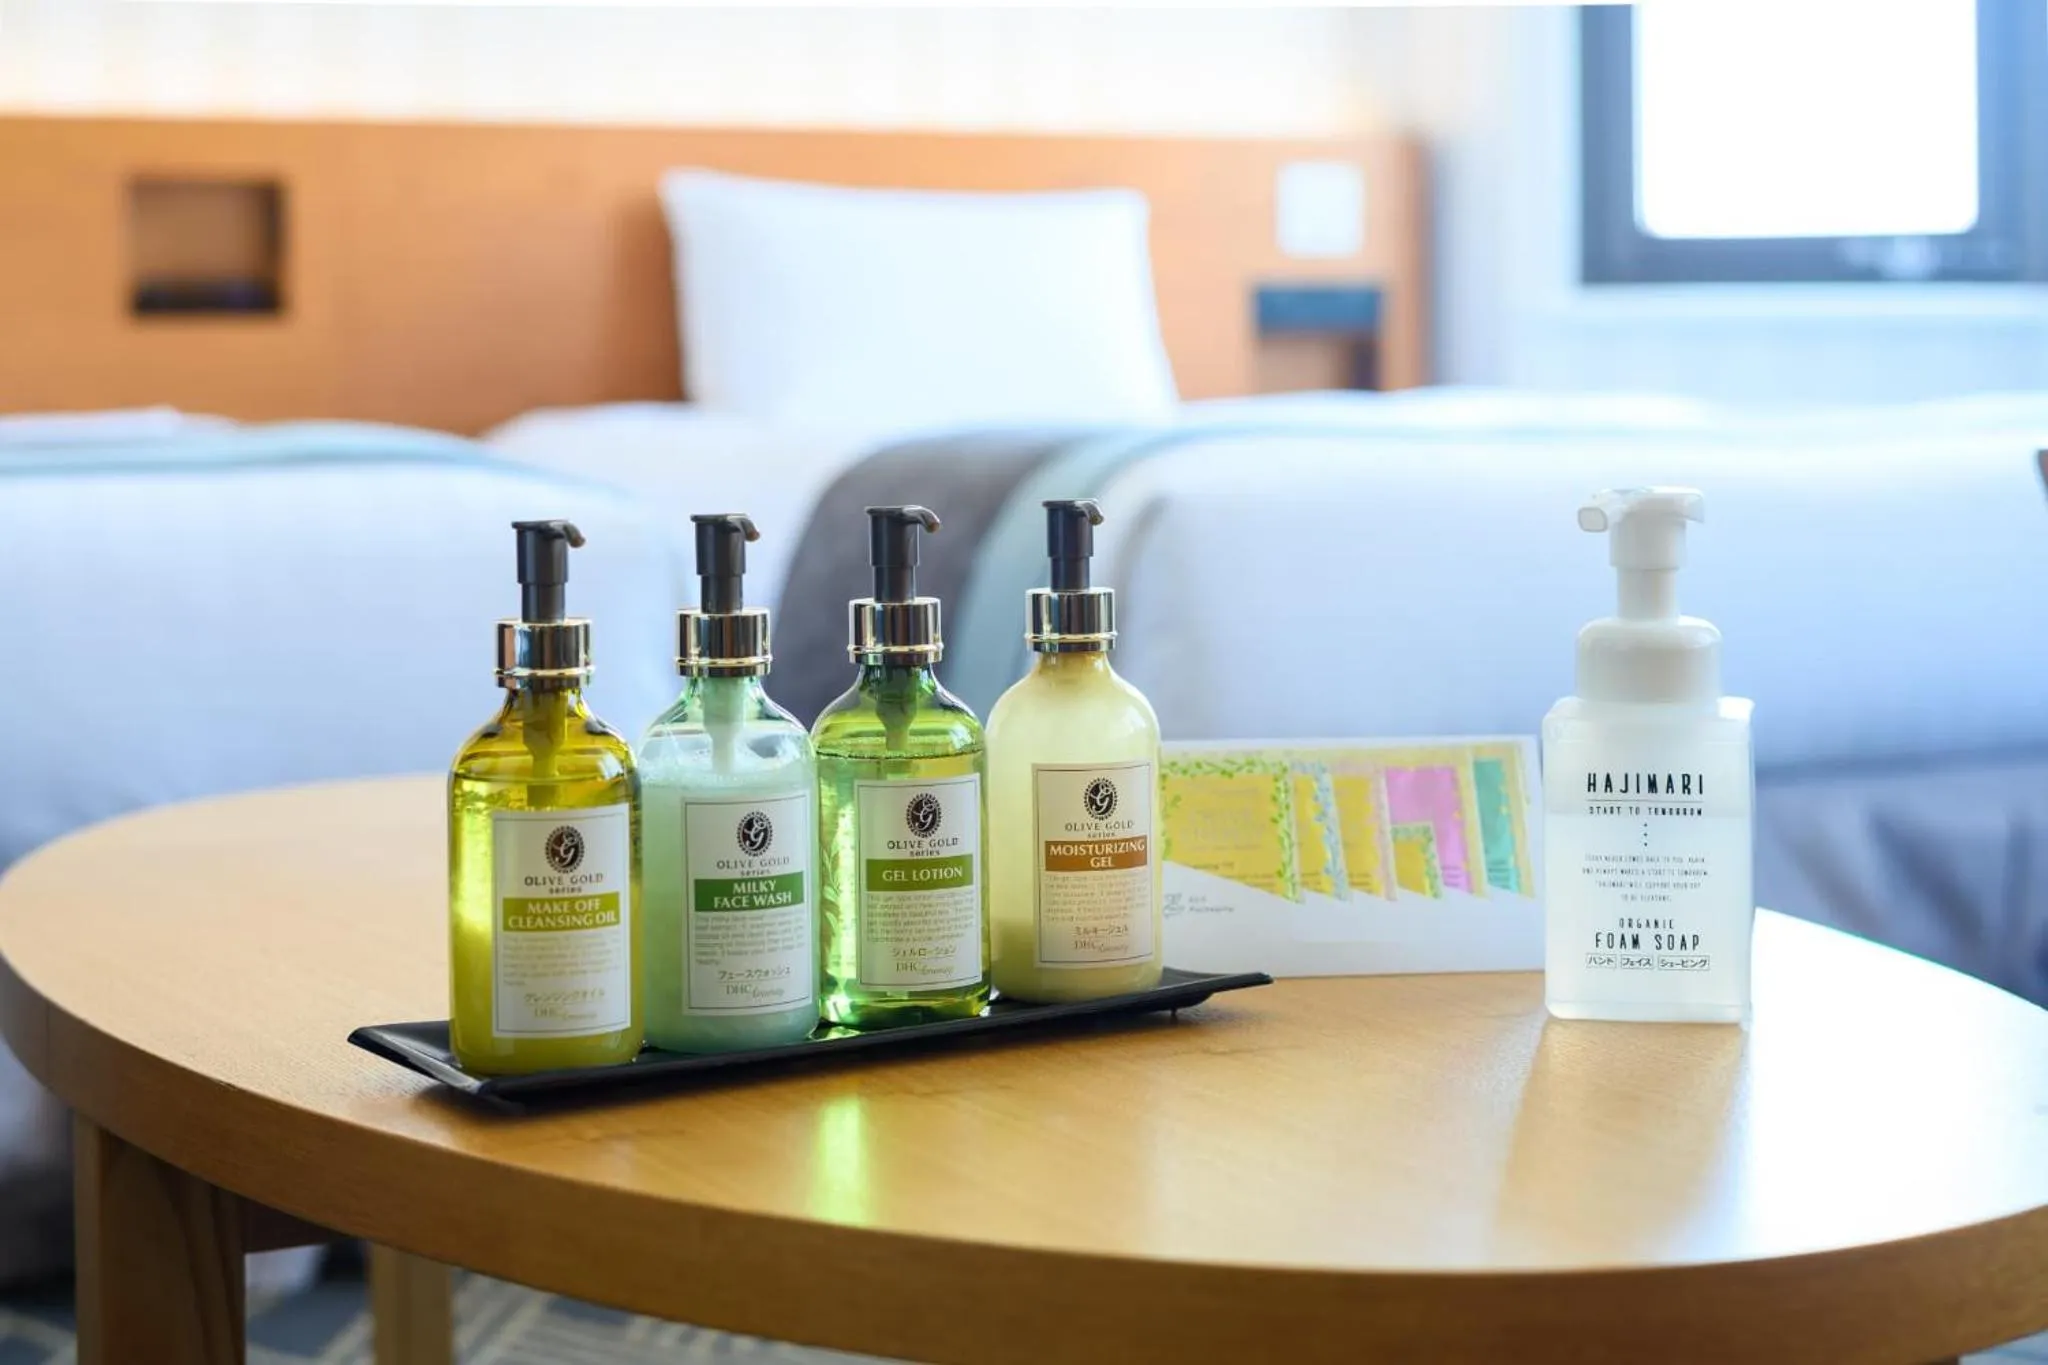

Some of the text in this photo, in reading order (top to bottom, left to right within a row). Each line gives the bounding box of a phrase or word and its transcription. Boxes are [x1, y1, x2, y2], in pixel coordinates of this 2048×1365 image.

[1587, 772, 1704, 795] HAJIMARI
[1589, 806, 1621, 816] START
[1629, 806, 1641, 816] TO
[1064, 820, 1135, 832] OLIVE GOLD
[886, 837, 959, 850] OLIVE GOLD
[1049, 840, 1146, 857] MOISTURIZING
[716, 856, 790, 870] OLIVE GOLD
[1090, 856, 1116, 869] GEL
[524, 873, 604, 886] OLIVE GOLD
[881, 866, 963, 882] GEL LOTION
[732, 879, 777, 895] MILKY
[527, 898, 601, 914] MAKE OFF
[713, 891, 793, 909] FACE WASH
[508, 910, 617, 929] CLEANSING OIL
[1619, 918, 1674, 929] ORGANIC
[1595, 932, 1699, 951] FOAM SOAP
[1622, 957, 1652, 967] フェイス
[1660, 959, 1708, 968] シェービング
